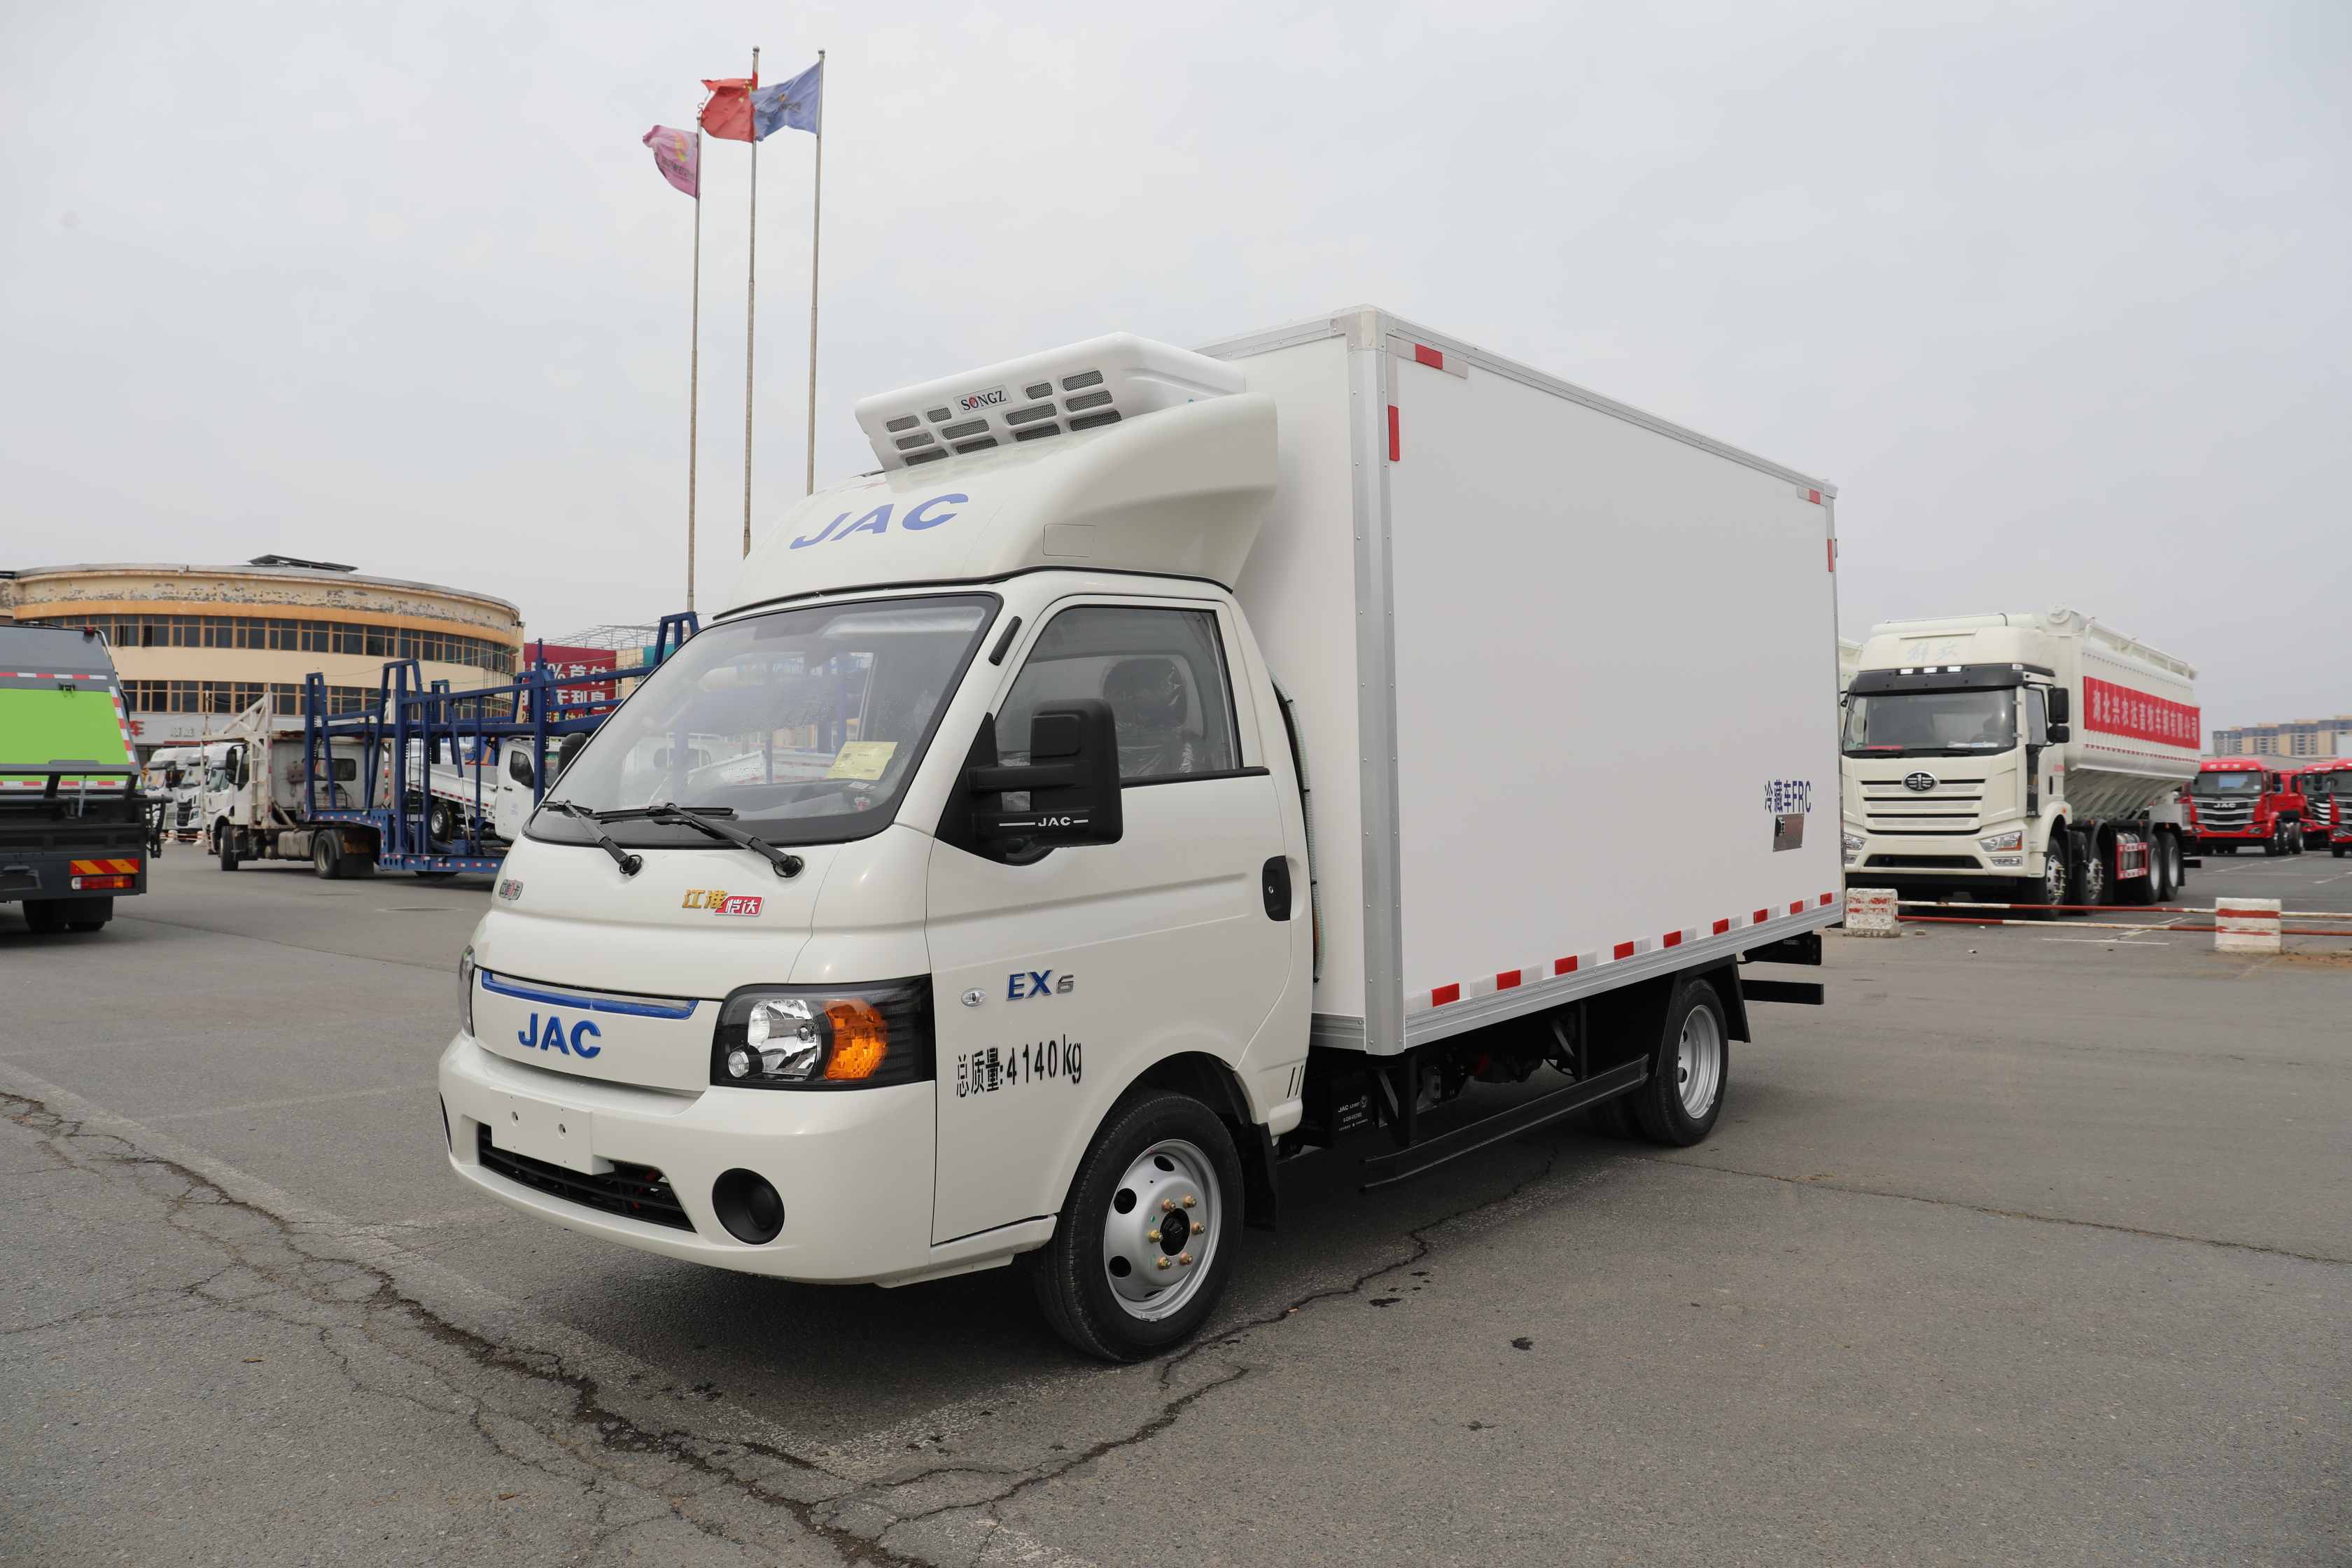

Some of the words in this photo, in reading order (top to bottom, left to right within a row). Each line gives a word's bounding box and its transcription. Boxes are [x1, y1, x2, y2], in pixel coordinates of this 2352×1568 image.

[960, 390, 1006, 410] SONGZ
[789, 493, 969, 550] JAC
[523, 662, 607, 686] %首付
[1764, 779, 1812, 814] 冷藏车FRC
[1037, 816, 1071, 827] JAC
[518, 1012, 601, 1059] JAC
